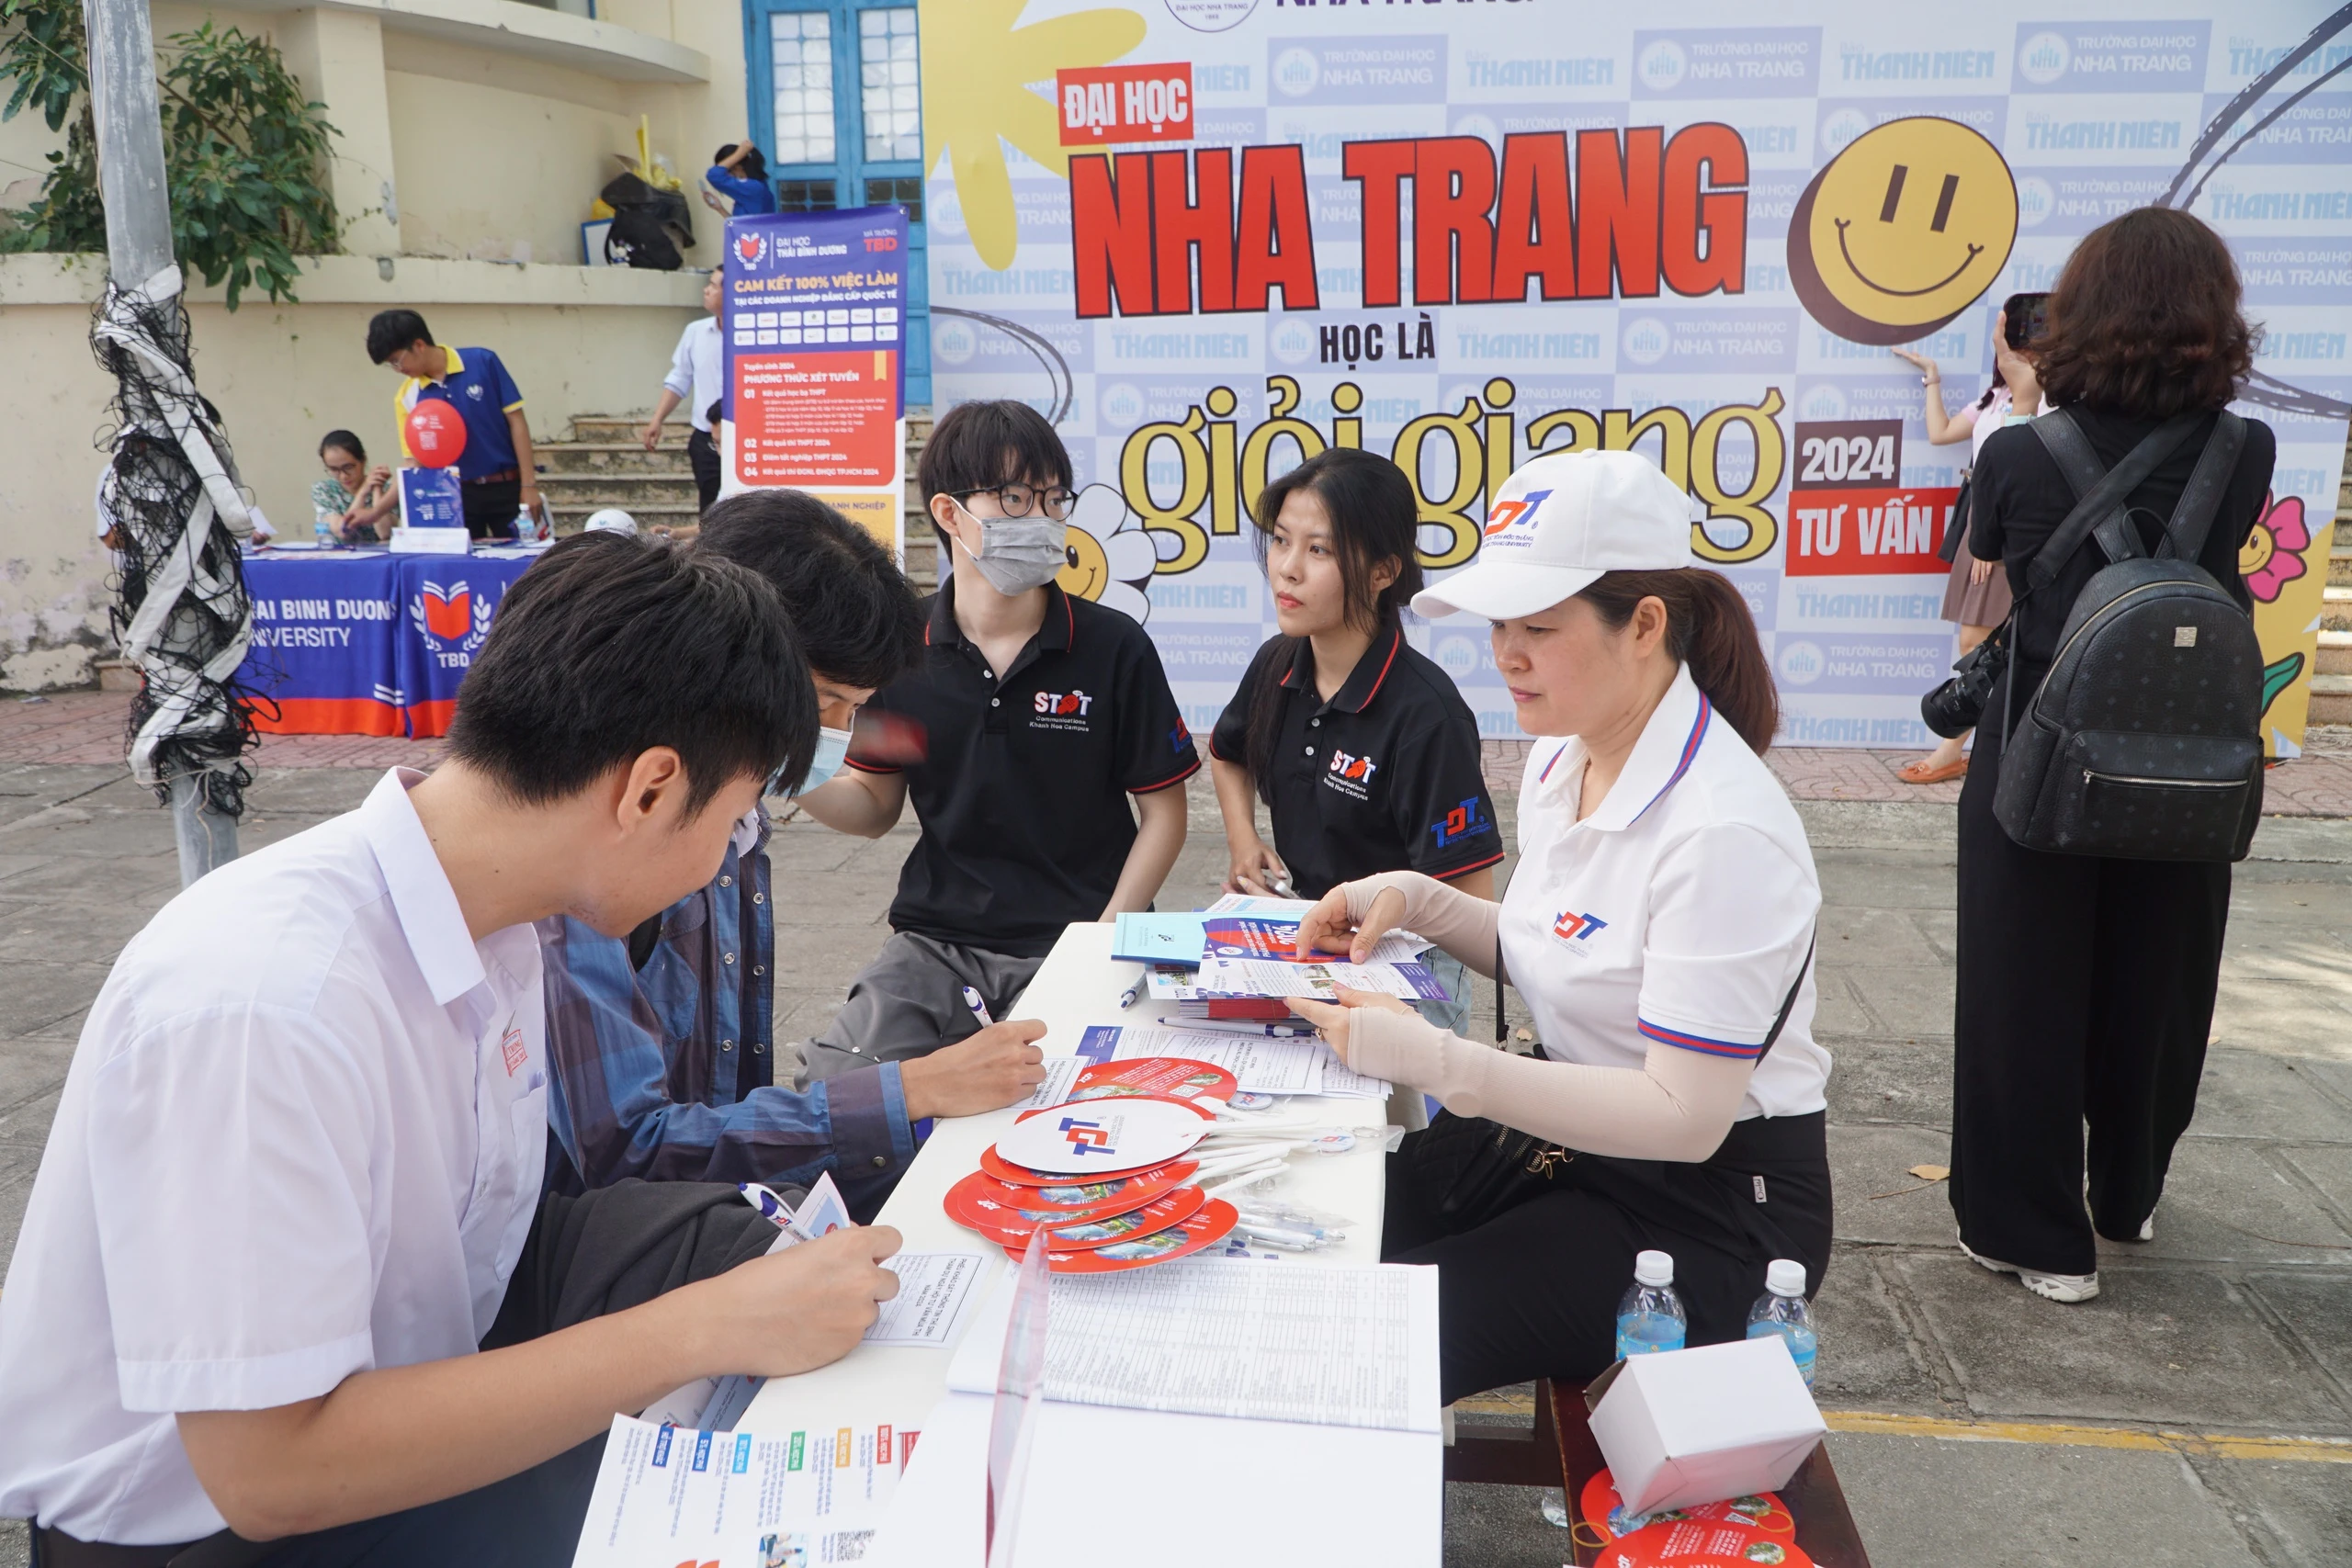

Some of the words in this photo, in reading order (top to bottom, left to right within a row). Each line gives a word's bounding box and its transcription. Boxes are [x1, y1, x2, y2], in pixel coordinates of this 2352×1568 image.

[1690, 61, 1733, 79] NHA
[1736, 60, 1804, 78] TRANG
[2074, 55, 2116, 72] NHA
[2120, 54, 2191, 72] TRANG
[1324, 70, 1363, 85] NHA
[1367, 68, 1433, 85] TRANG
[1064, 82, 1116, 136] ĐẠI
[1124, 77, 1188, 133] HỌC
[1069, 144, 1320, 320] NHA
[1341, 121, 1749, 309] TRANG
[864, 237, 898, 252] TBD
[735, 279, 764, 292] CAM
[766, 275, 793, 291] KẾT
[796, 276, 829, 290] 100%
[831, 272, 864, 290] VIỆC
[866, 270, 898, 287] LÀM
[2242, 269, 2284, 286] NHA
[1319, 324, 1383, 370] HỌC
[1397, 311, 1435, 359] LÀ
[1673, 339, 1714, 355] NHA
[1718, 338, 1783, 355] TRANG
[743, 389, 755, 399] 01
[743, 438, 757, 449] 02
[743, 452, 757, 463] 03
[1801, 434, 1894, 481] 2024
[743, 467, 758, 477] 04
[1390, 376, 1786, 570] gig
[1484, 489, 1555, 538] DT
[1796, 504, 1848, 556] TƯ
[1857, 494, 1933, 555] VẤN
[252, 600, 277, 620] AI
[281, 600, 330, 620] BINH
[437, 652, 469, 668] TBD
[1827, 661, 1867, 677] NHA
[1871, 660, 1936, 678] TRANG
[1430, 795, 1478, 849] TDT
[1272, 926, 1298, 945] 2024
[1058, 1117, 1115, 1156] TDT
[773, 1215, 794, 1226] TDT
